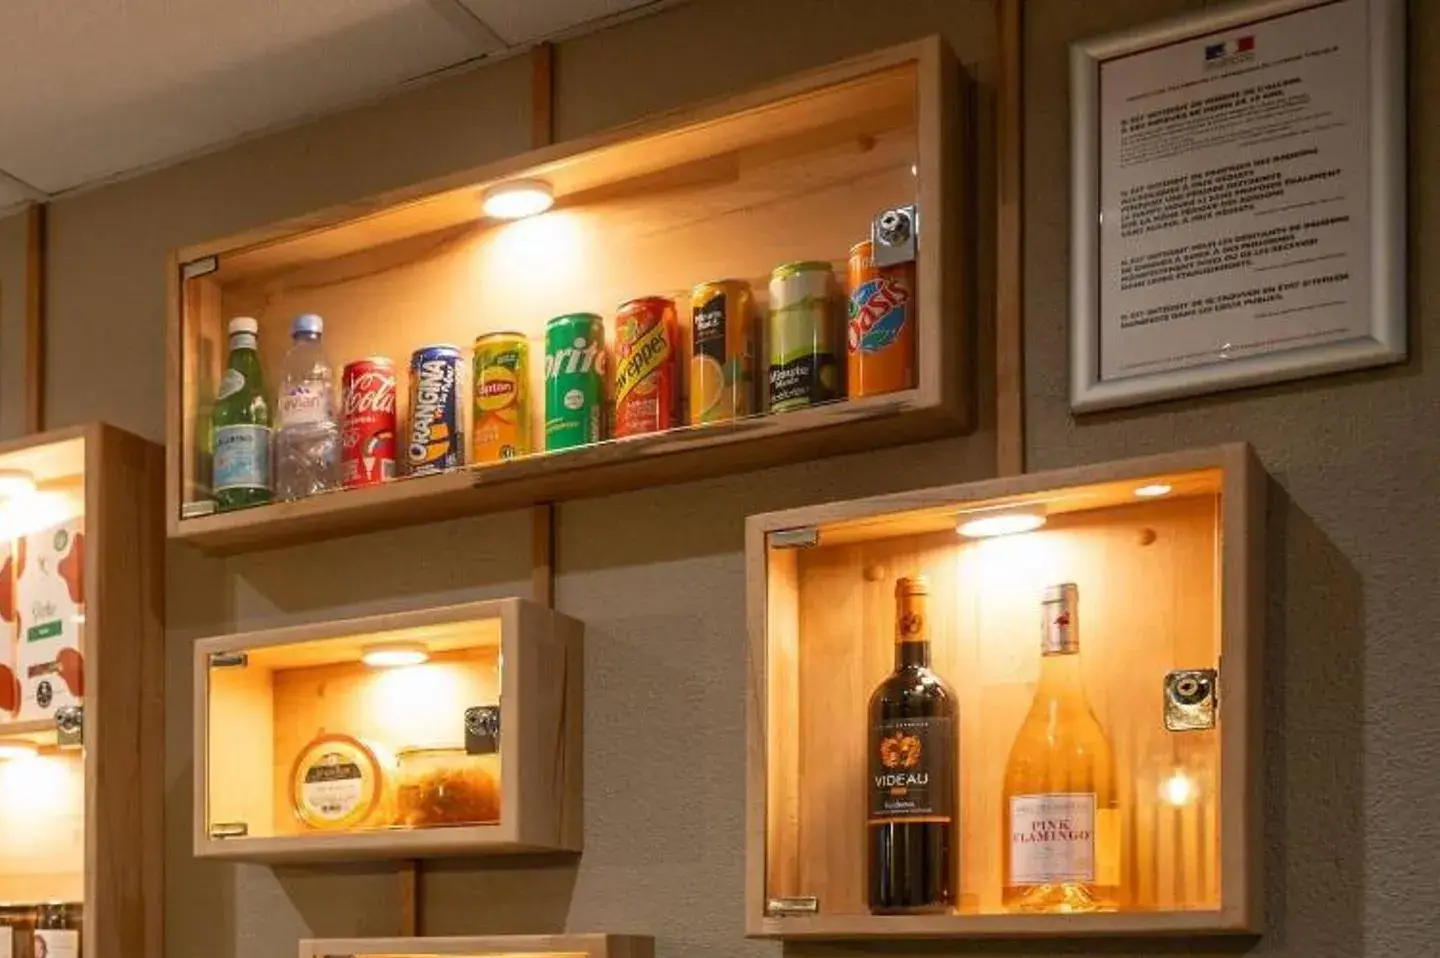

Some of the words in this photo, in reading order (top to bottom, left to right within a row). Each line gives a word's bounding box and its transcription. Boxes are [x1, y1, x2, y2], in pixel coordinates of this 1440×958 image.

[408, 360, 447, 463] ORANGINA
[874, 772, 929, 788] VIDEAU
[1032, 818, 1071, 832] PINK
